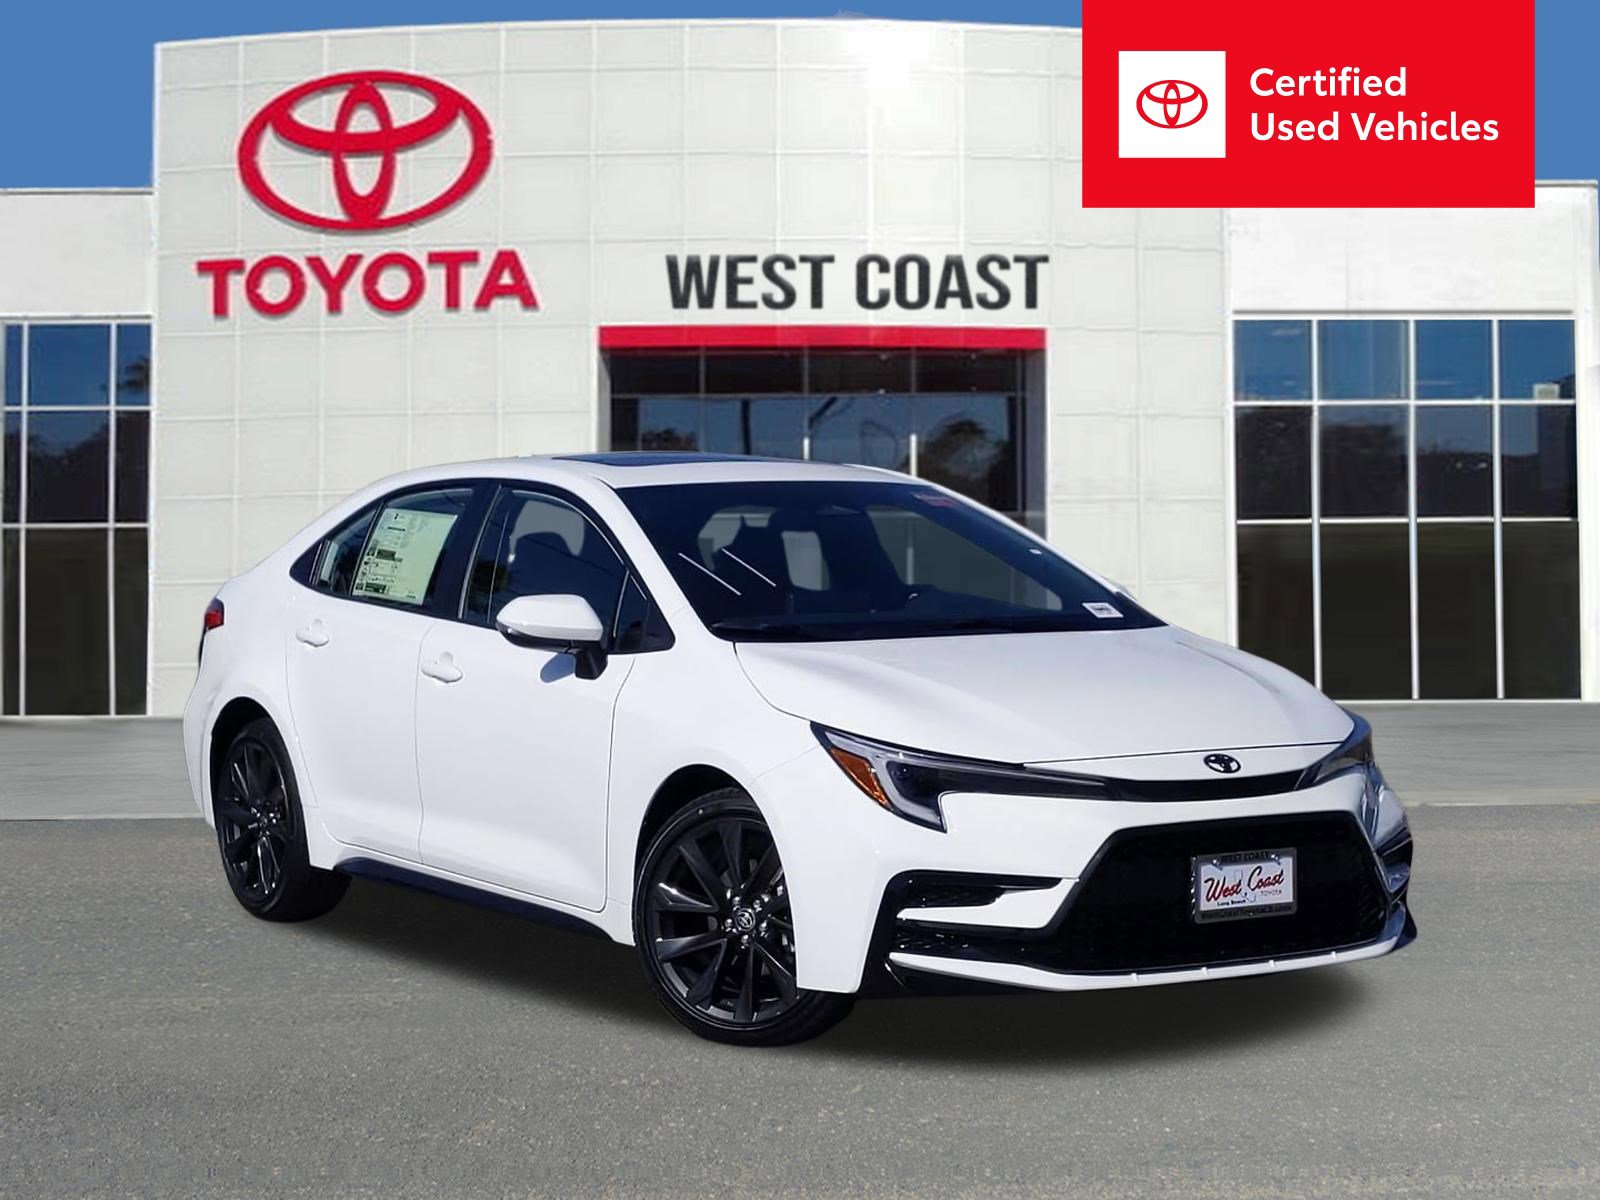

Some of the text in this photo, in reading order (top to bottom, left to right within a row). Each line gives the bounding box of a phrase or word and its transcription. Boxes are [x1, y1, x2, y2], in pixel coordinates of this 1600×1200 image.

[195, 249, 538, 318] TOYOTA
[666, 254, 1050, 310] WEST COAST
[1204, 866, 1284, 902] West Coast
